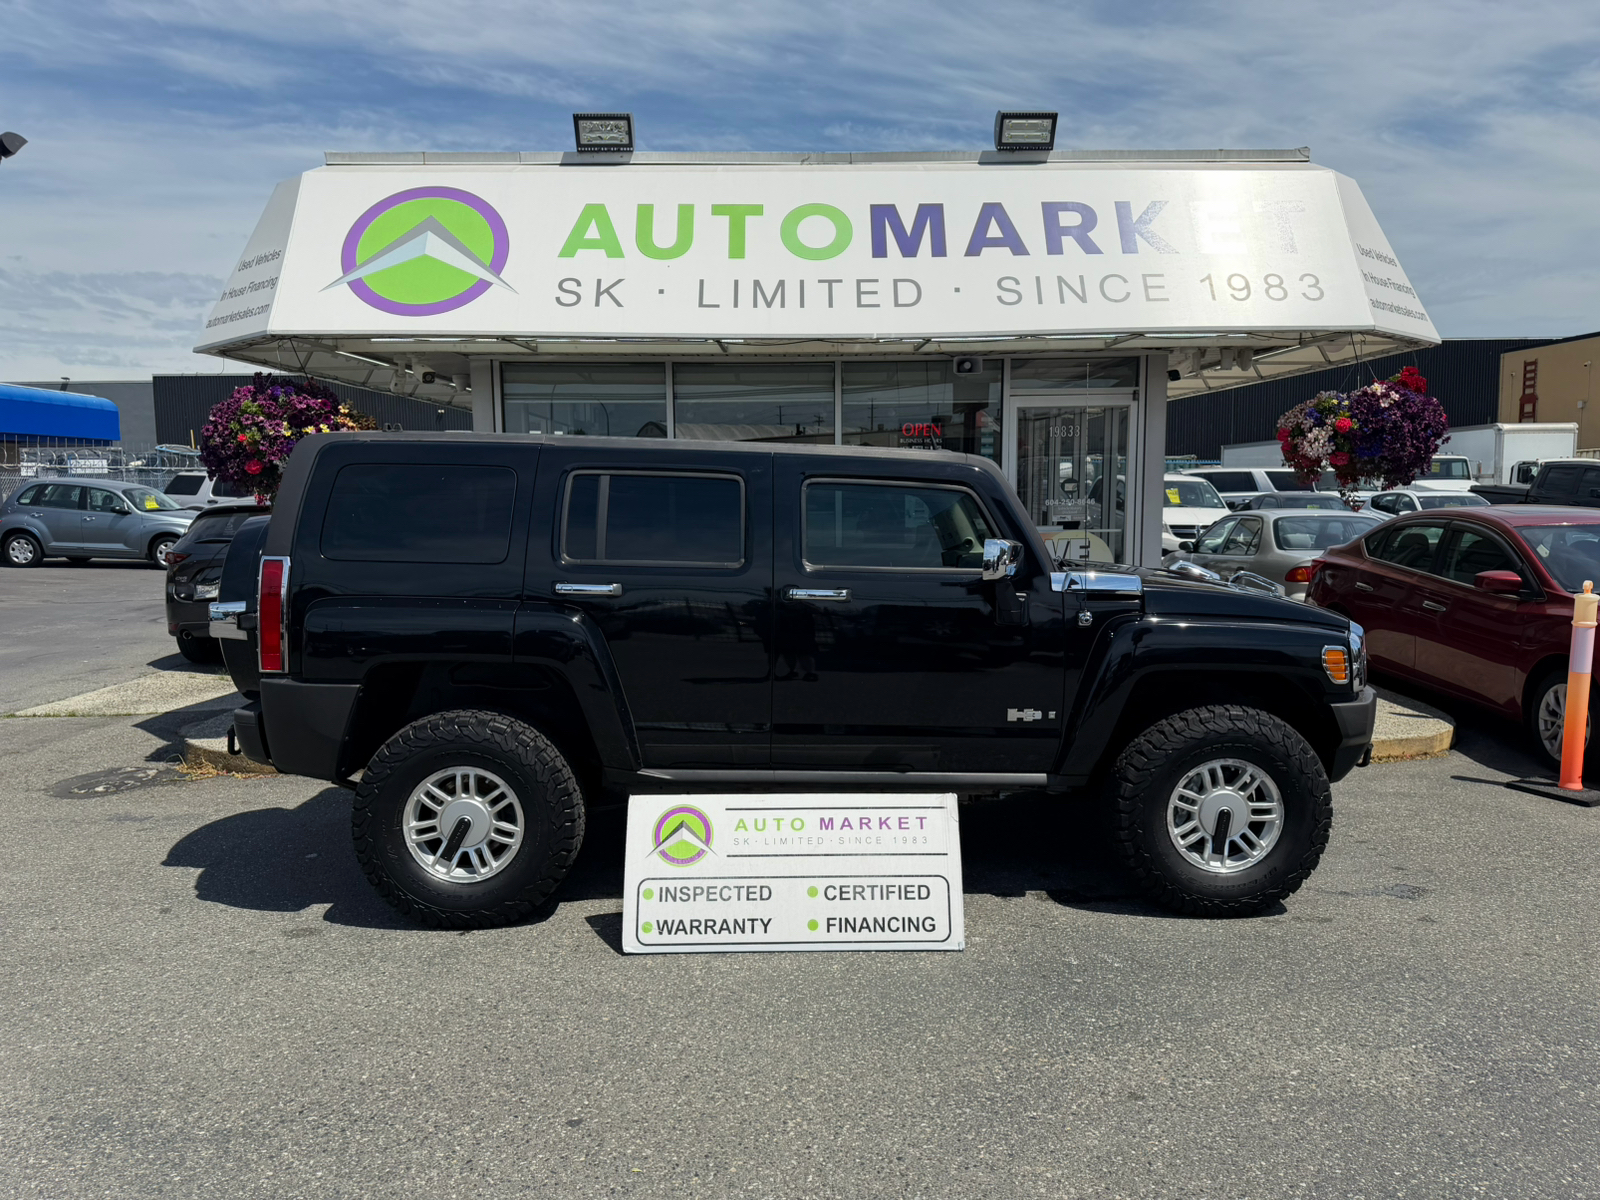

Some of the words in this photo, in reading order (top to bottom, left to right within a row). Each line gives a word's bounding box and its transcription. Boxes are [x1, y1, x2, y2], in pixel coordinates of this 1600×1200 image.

[237, 256, 255, 272] Used
[254, 249, 282, 267] Vehicles
[1356, 243, 1375, 260] Used
[1372, 249, 1398, 267] Vehicles
[220, 290, 228, 302] In
[226, 286, 247, 299] House
[246, 276, 279, 295] Financing
[555, 277, 626, 308] SK
[698, 278, 923, 308] LIMITED
[995, 273, 1170, 305] SINCE
[1200, 272, 1325, 302] 1983
[1361, 269, 1370, 282] In
[1368, 272, 1390, 288] House
[1387, 278, 1417, 299] Financing
[205, 303, 271, 329] automarketsales.com
[902, 422, 943, 436] OPEN
[1049, 424, 1081, 438] 19833
[734, 817, 806, 833] AUTO
[818, 816, 929, 832] MARKET
[764, 836, 825, 846] LIMITED
[838, 835, 883, 845] SINCE
[892, 835, 929, 845] 1983
[658, 885, 773, 903] INSPECTED
[823, 884, 931, 902] CERTIFIED
[656, 917, 773, 936] WARRANTY
[826, 916, 937, 934] FINANCING
